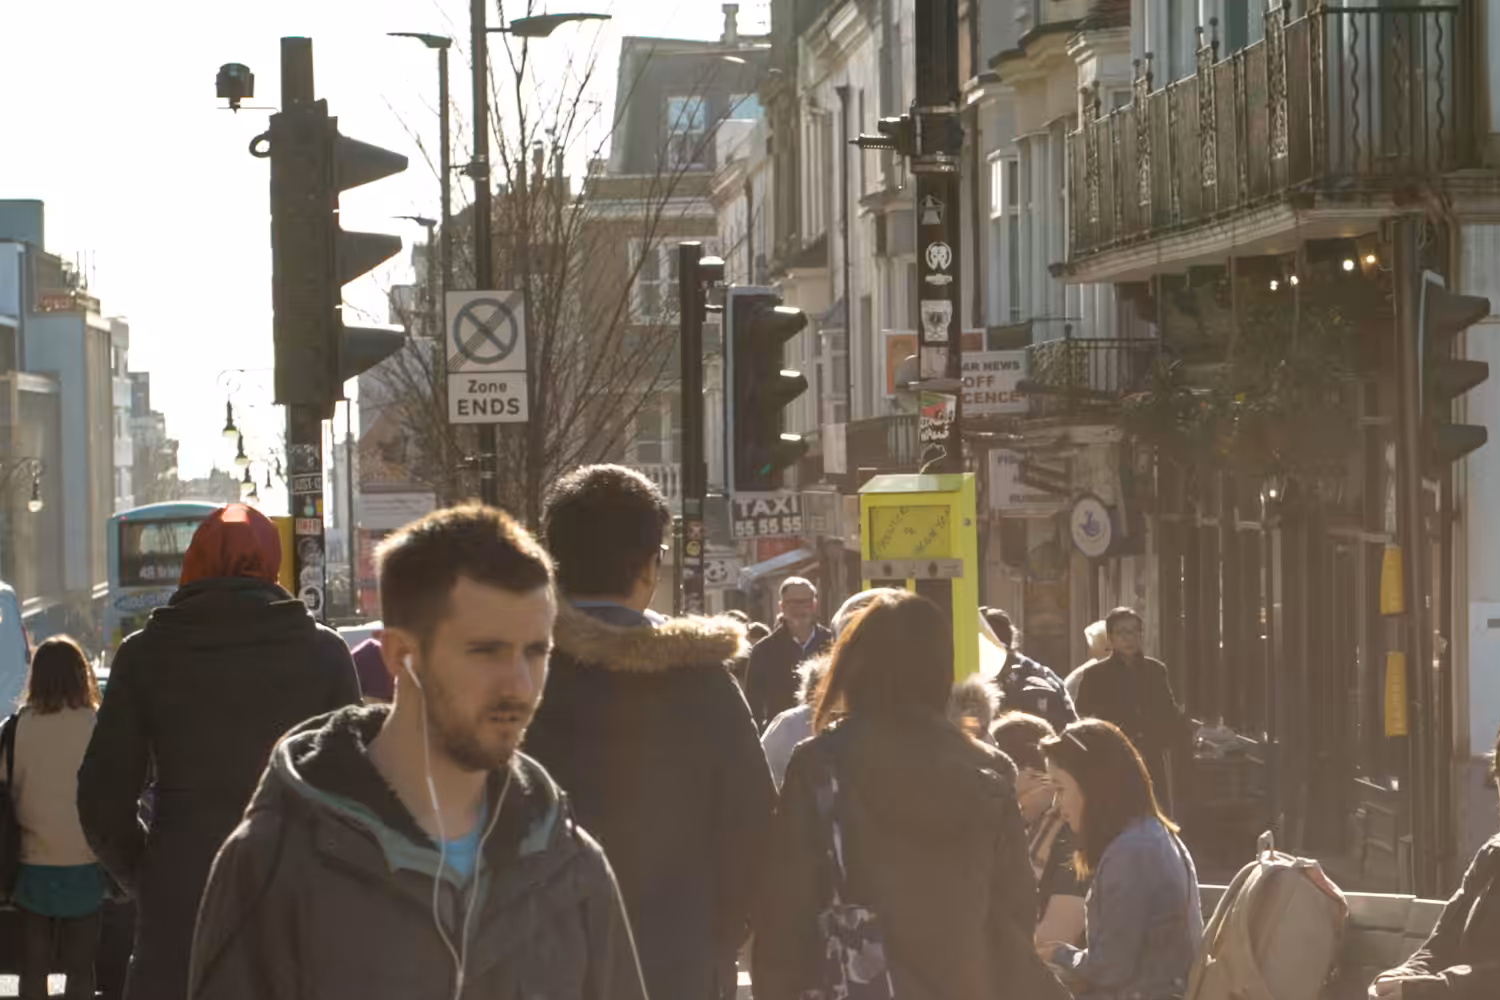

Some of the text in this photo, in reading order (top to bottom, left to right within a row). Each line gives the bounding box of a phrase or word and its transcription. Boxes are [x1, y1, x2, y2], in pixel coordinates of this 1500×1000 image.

[962, 360, 1021, 372] AR NEWS
[467, 379, 508, 394] Zone
[963, 375, 996, 389] OFF
[961, 391, 1021, 405] CENCE
[457, 398, 520, 416] ENDS
[735, 495, 799, 517] TAXI
[735, 516, 802, 536] 55 55 55
